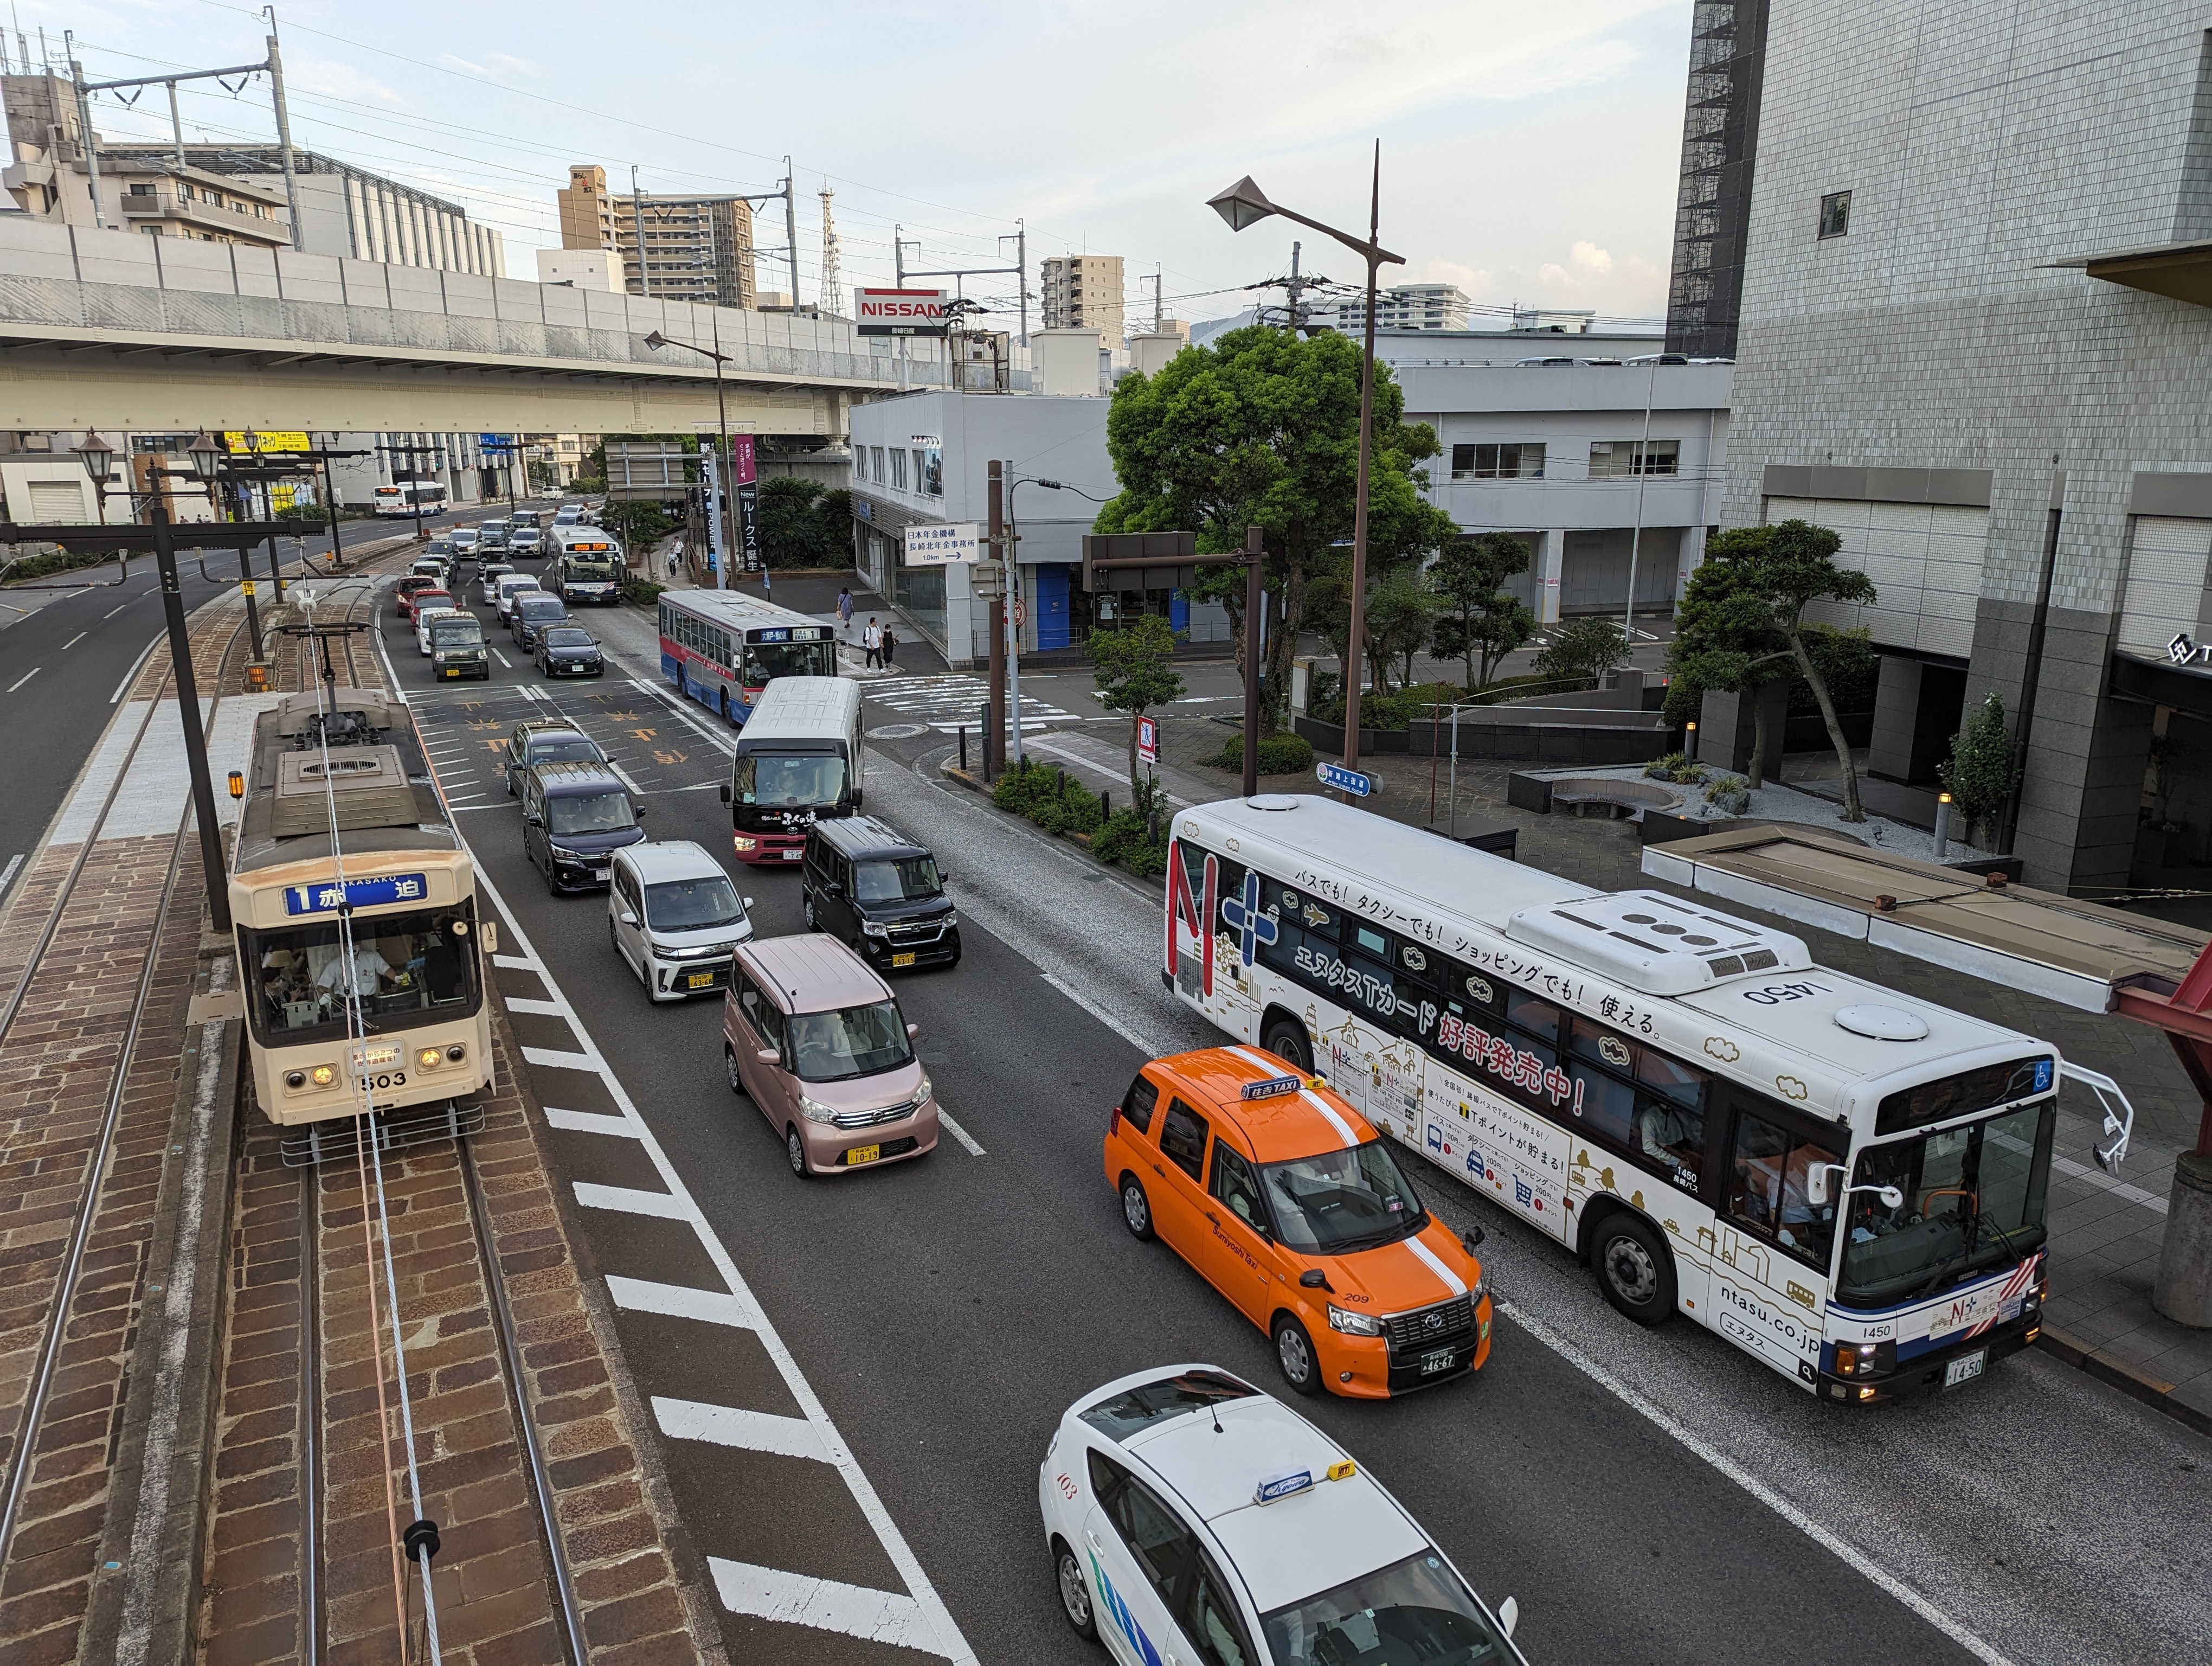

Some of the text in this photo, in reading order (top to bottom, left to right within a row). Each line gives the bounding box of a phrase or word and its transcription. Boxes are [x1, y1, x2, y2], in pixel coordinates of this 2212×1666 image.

[862, 303, 942, 316] NISSAN
[743, 501, 756, 547] ルークス
[908, 529, 956, 540] 日本年金機構
[909, 539, 975, 551] 長崎北年金事務所
[746, 549, 758, 571] 誕生
[1328, 770, 1364, 788] 新浦上街道
[295, 886, 311, 911] 1
[1294, 945, 1437, 1035] エヌタスTカード
[1742, 981, 1834, 1004] 1450
[1600, 994, 1660, 1040] 使える。
[361, 1072, 406, 1092] 503
[1251, 1081, 1297, 1097] 住吉 TAXI
[1427, 1088, 1457, 1112] 使うたびに
[856, 1151, 877, 1162] 10-19
[1673, 1174, 1698, 1193] 長崎バス
[1677, 1166, 1697, 1183] 1450
[1544, 1207, 1558, 1218] ポイント
[1212, 1226, 1259, 1270] Sumiyoshi Taxi
[1958, 1270, 1978, 1281] ISUZU
[1344, 1293, 1369, 1304] 209
[1721, 1286, 1819, 1354] ntasu.co.jp
[1726, 1321, 1765, 1350] エヌタス
[1863, 1325, 1891, 1338] 1450
[1427, 1355, 1454, 1372] 46-67
[1953, 1359, 1982, 1382] 14-50
[1956, 1356, 1974, 1367] 長崎230
[1057, 1472, 1077, 1500] 103
[1257, 1482, 1264, 1499] 共和
[1269, 1478, 1306, 1495] Kyowa
